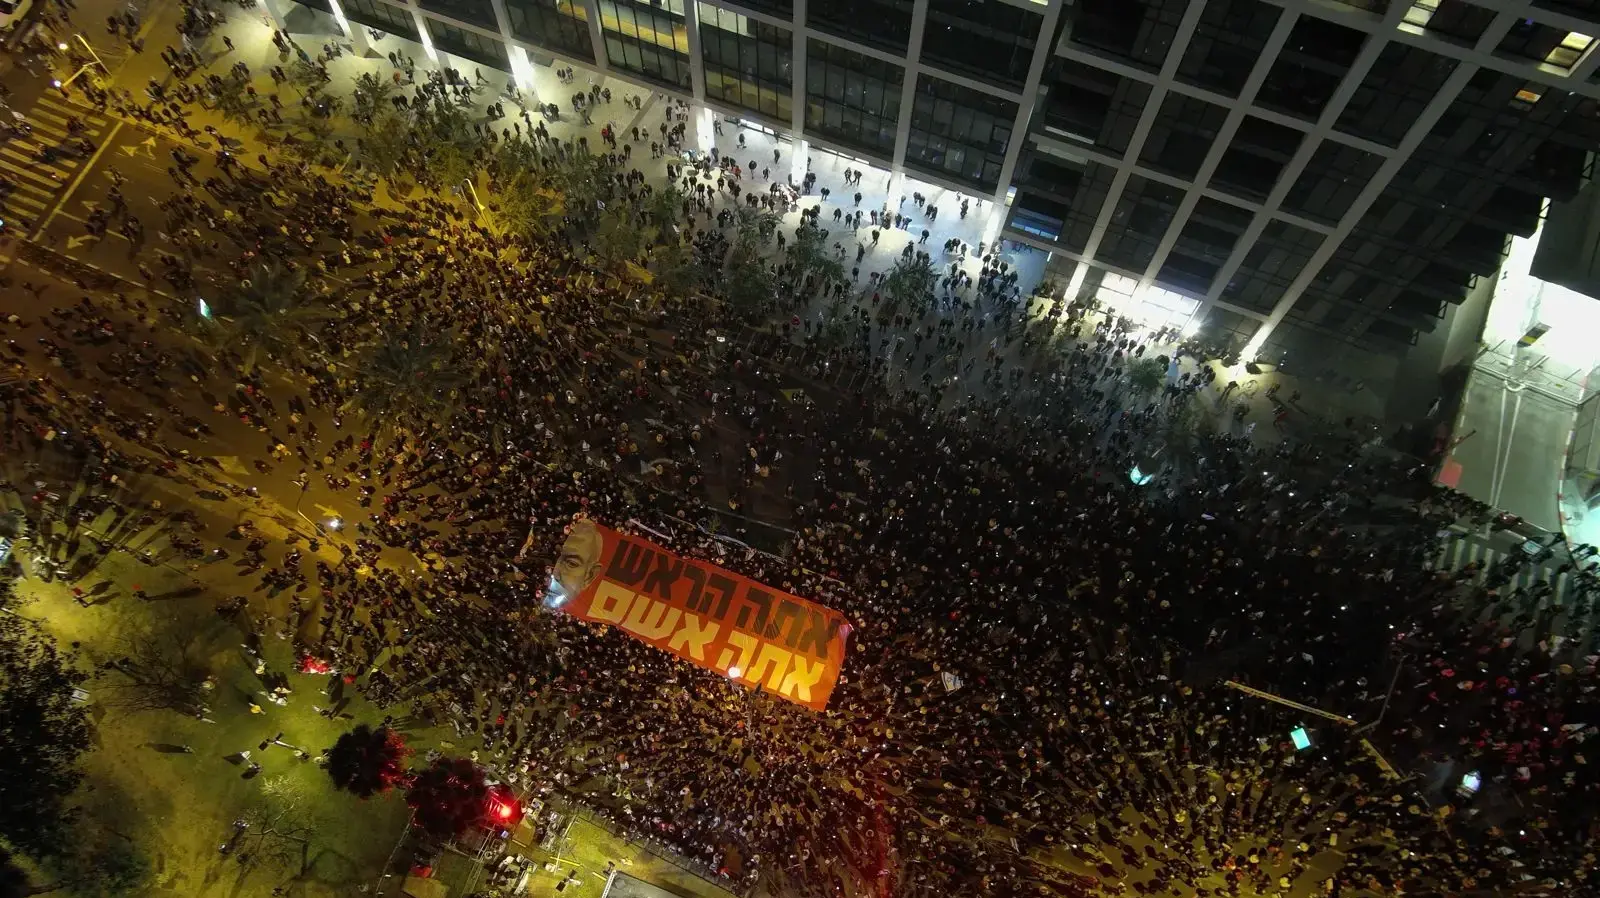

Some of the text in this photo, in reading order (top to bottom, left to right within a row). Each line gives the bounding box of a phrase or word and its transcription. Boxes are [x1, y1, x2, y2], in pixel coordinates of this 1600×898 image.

[587, 581, 825, 702] אתה אשם
[605, 540, 841, 658] אתה הראש
